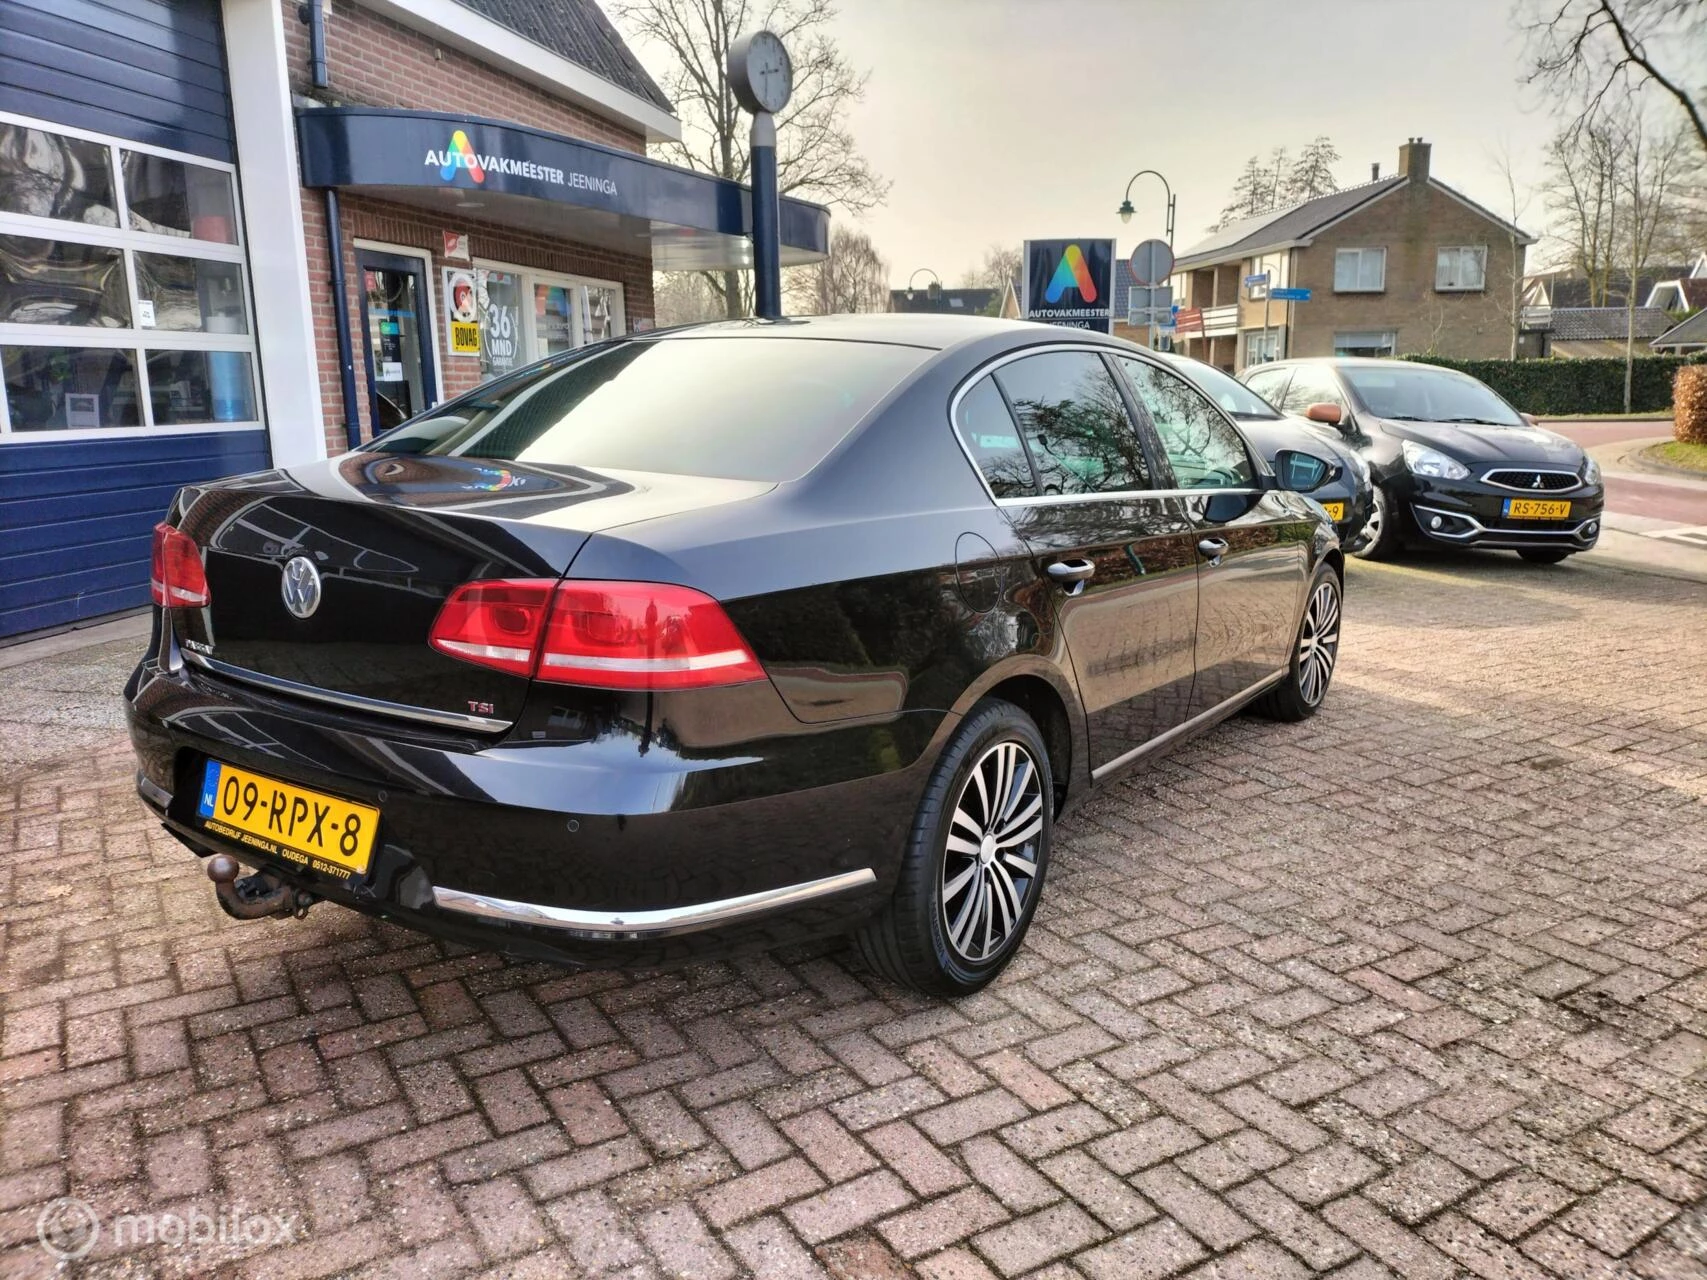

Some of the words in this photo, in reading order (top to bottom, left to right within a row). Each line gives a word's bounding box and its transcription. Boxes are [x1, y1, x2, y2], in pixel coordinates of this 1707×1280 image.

[424, 150, 564, 185] AUTOVAKMEESTER
[567, 172, 618, 196] JEENINGA
[489, 304, 511, 338] 36
[1029, 308, 1112, 318] AUTOVAKMEESTER
[455, 327, 478, 347] BOVAG
[492, 339, 512, 356] MND
[1514, 502, 1566, 515] RS-756-V
[467, 701, 494, 714] TSI
[204, 793, 214, 807] NL
[223, 776, 361, 856] 09-RPX-8
[204, 821, 241, 839] AUTOBEDRIJF
[241, 834, 278, 854] JEENINGA.NL
[282, 849, 308, 865] OUDEGA
